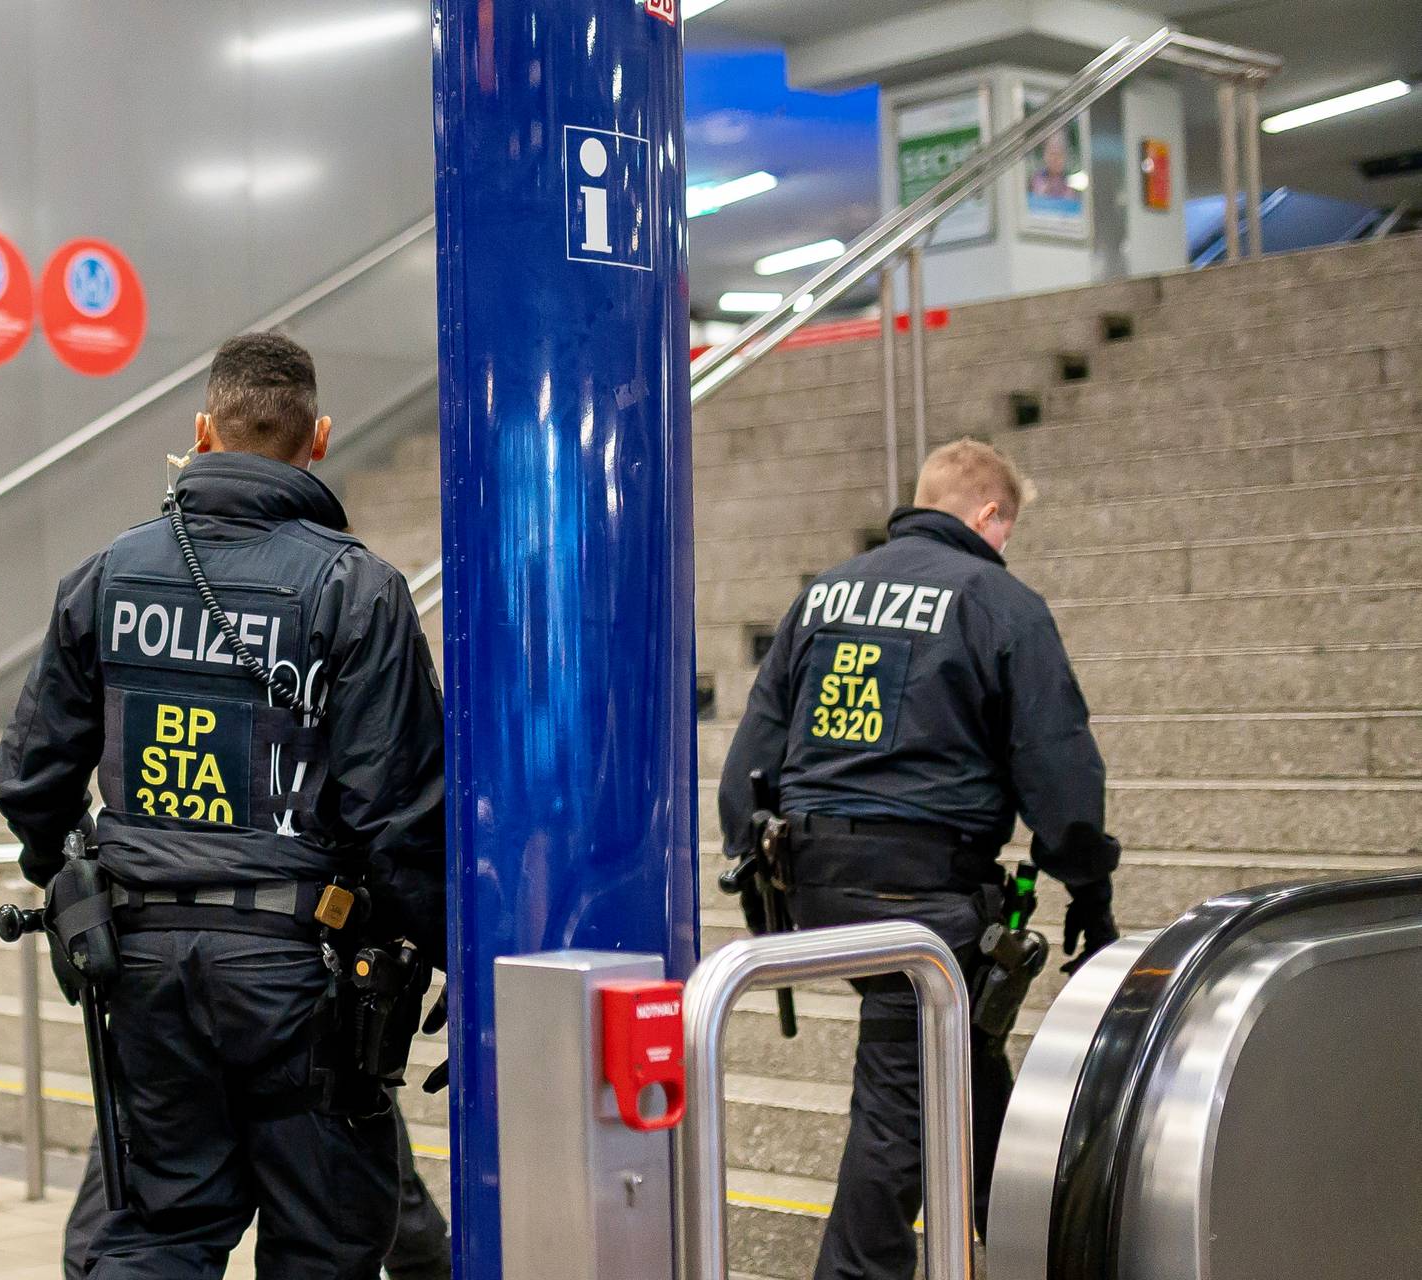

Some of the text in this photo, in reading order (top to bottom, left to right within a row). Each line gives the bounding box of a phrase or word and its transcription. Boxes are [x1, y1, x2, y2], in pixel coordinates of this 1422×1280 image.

[802, 580, 953, 634] POLIZEI
[111, 601, 280, 668] POLIZEI
[833, 642, 881, 674] BP
[820, 674, 881, 709] STA
[156, 704, 216, 746] BP
[811, 706, 883, 743] 3320
[141, 746, 226, 793] STA
